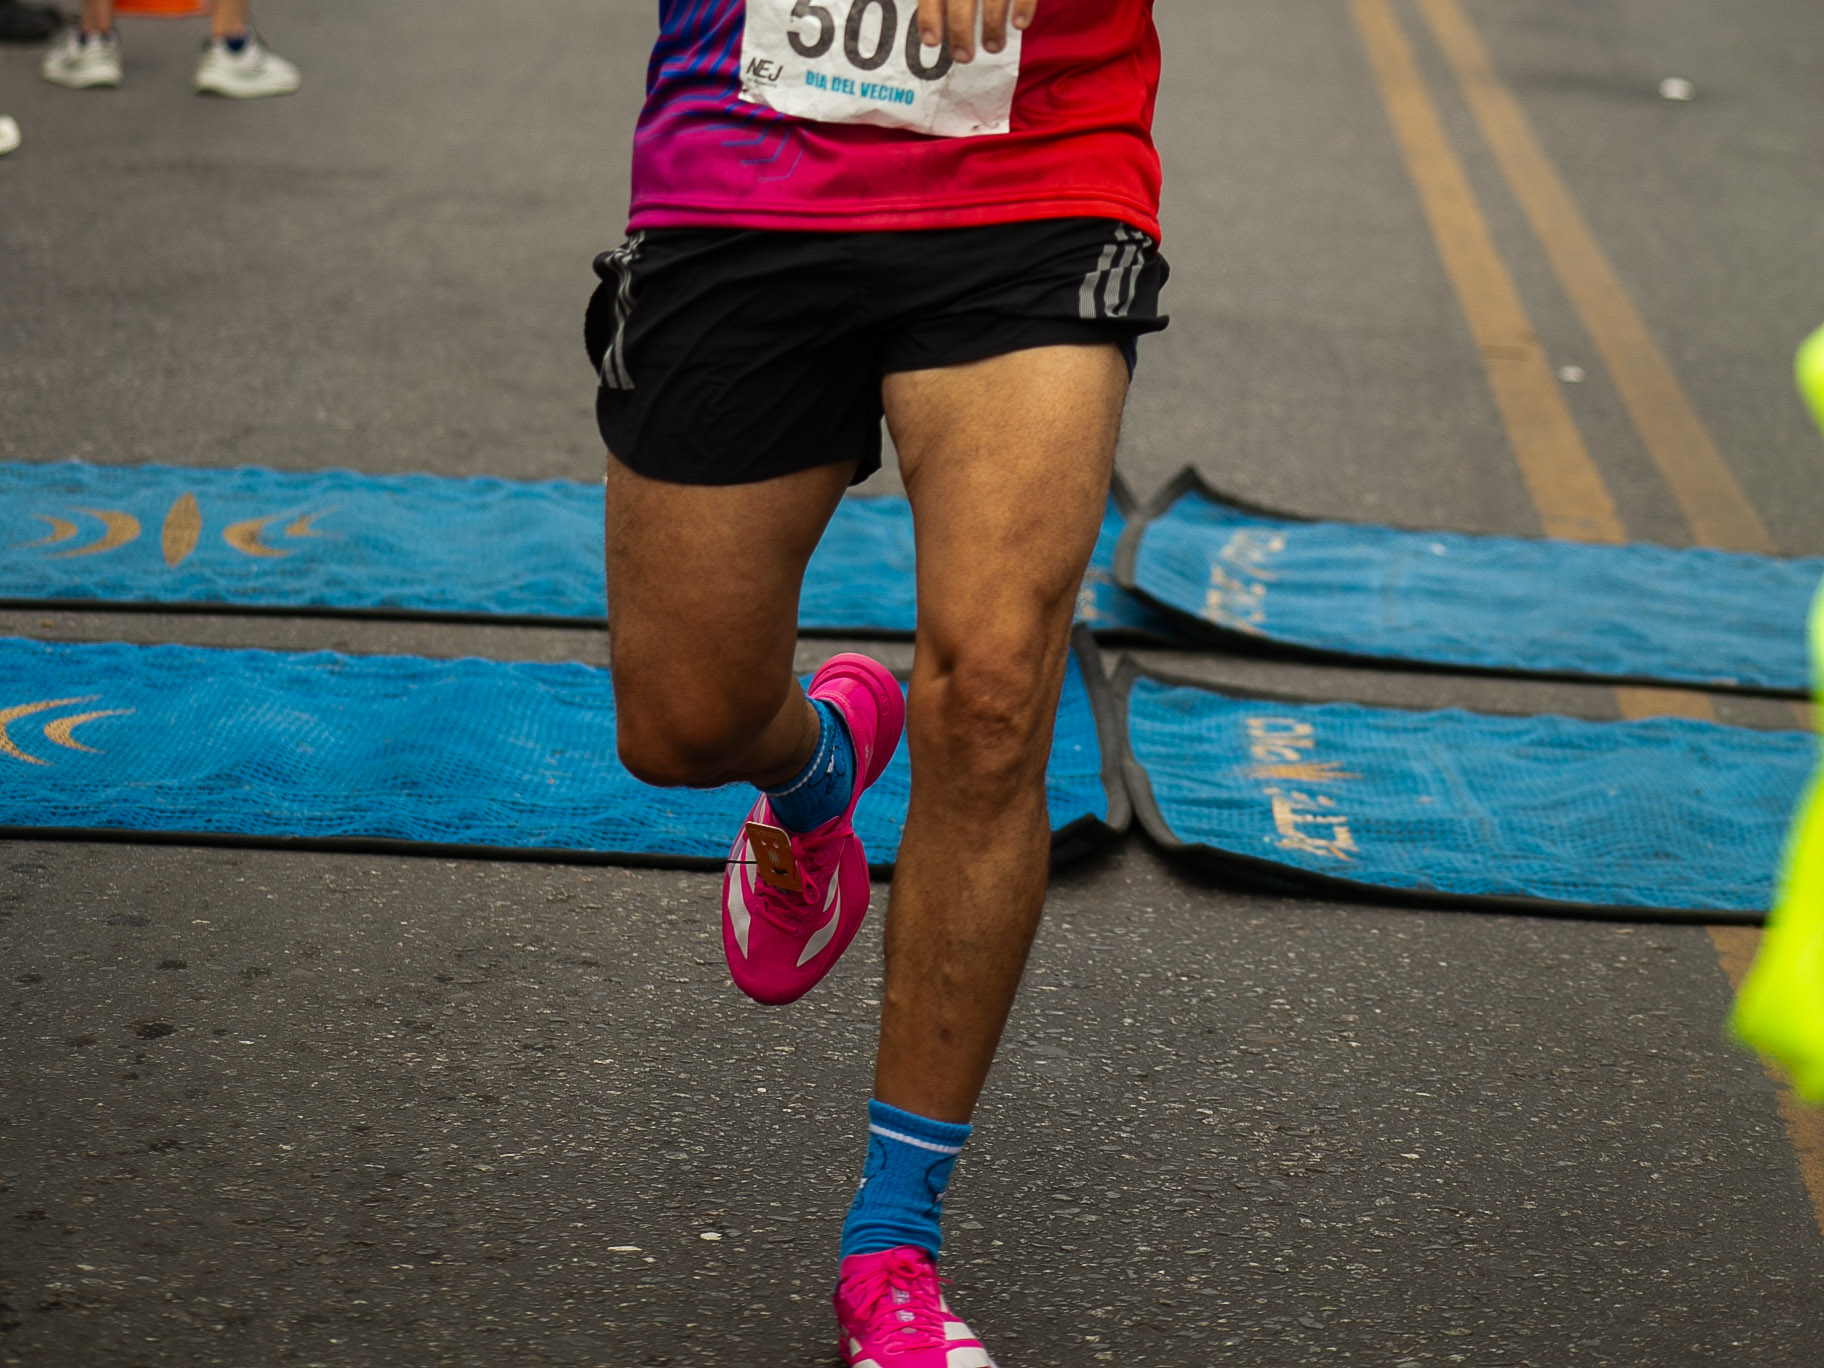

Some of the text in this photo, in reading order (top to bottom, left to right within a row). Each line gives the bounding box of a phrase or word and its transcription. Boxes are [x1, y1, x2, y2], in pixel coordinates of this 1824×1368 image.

[746, 56, 784, 82] NEJ
[804, 69, 915, 106] DIA DEL VECINO
